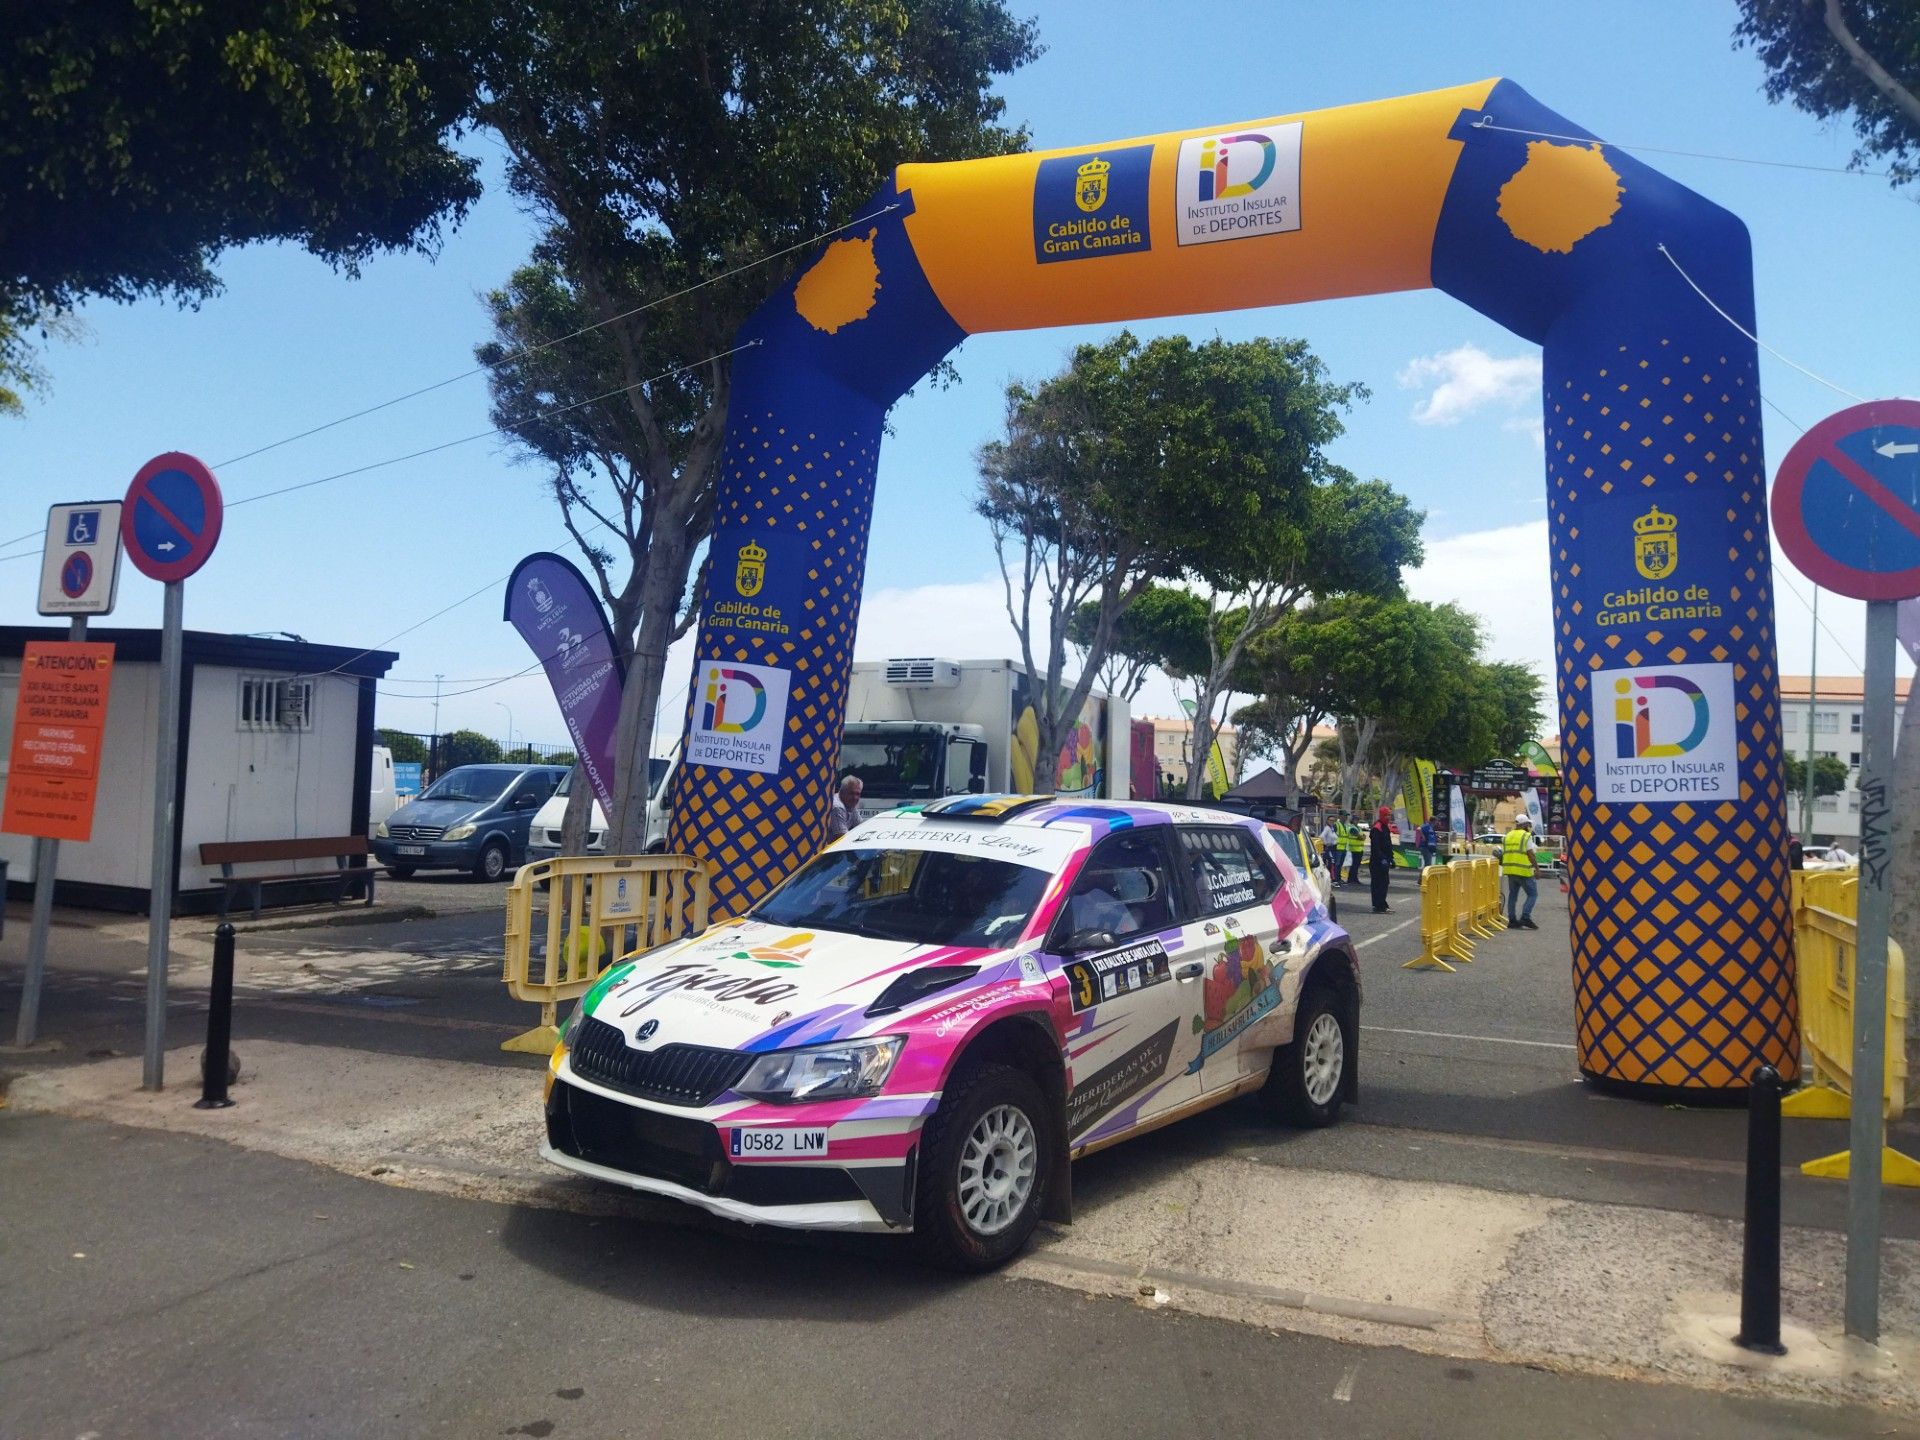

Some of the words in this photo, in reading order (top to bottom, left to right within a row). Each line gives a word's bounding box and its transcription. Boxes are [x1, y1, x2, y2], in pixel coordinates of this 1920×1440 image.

[1188, 202, 1240, 219] INSTITUTO
[1243, 196, 1288, 211] INSULAR
[1048, 218, 1106, 238] Cabildo
[1110, 216, 1130, 230] de
[1210, 211, 1282, 233] DEPORTES
[1043, 238, 1080, 254] Gran
[1083, 230, 1141, 250] Canaria
[1603, 586, 1680, 608] Cabildo
[1684, 584, 1710, 601] de
[714, 601, 760, 617] Cabildo
[762, 606, 782, 618] de
[1596, 609, 1641, 627] Gran
[1645, 602, 1722, 622] Canaria
[709, 614, 733, 628] Gran
[736, 616, 790, 634] Canaria
[36, 654, 96, 670] ATENCIÓN
[72, 684, 99, 694] SANTA
[561, 678, 592, 706] ACTIVIDAD
[568, 682, 600, 709] DEPORTES
[47, 696, 59, 704] DE
[60, 696, 100, 706] TIRAJANA
[53, 708, 89, 720] CANARIA
[38, 728, 74, 740] PARKING
[694, 732, 730, 746] INSTITUTO
[732, 736, 772, 752] INSULAR
[34, 754, 74, 766] CERRADO
[704, 746, 766, 766] DEPORTES
[1606, 762, 1667, 776] INSTITUTO
[1672, 760, 1726, 774] INSULAR
[1630, 776, 1720, 794] DEPORTES
[876, 830, 972, 844] CAFETERÍA
[1213, 888, 1256, 909] J.Hernández
[1105, 954, 1126, 970] RALLYE
[1123, 950, 1132, 964] DE
[1130, 946, 1149, 962] SANTA
[1073, 964, 1092, 1006] 3
[719, 1004, 762, 1024] NATURAL
[1074, 1062, 1138, 1107] HEREDERAS
[744, 1134, 784, 1150] 0582
[794, 1132, 825, 1150] LNW
